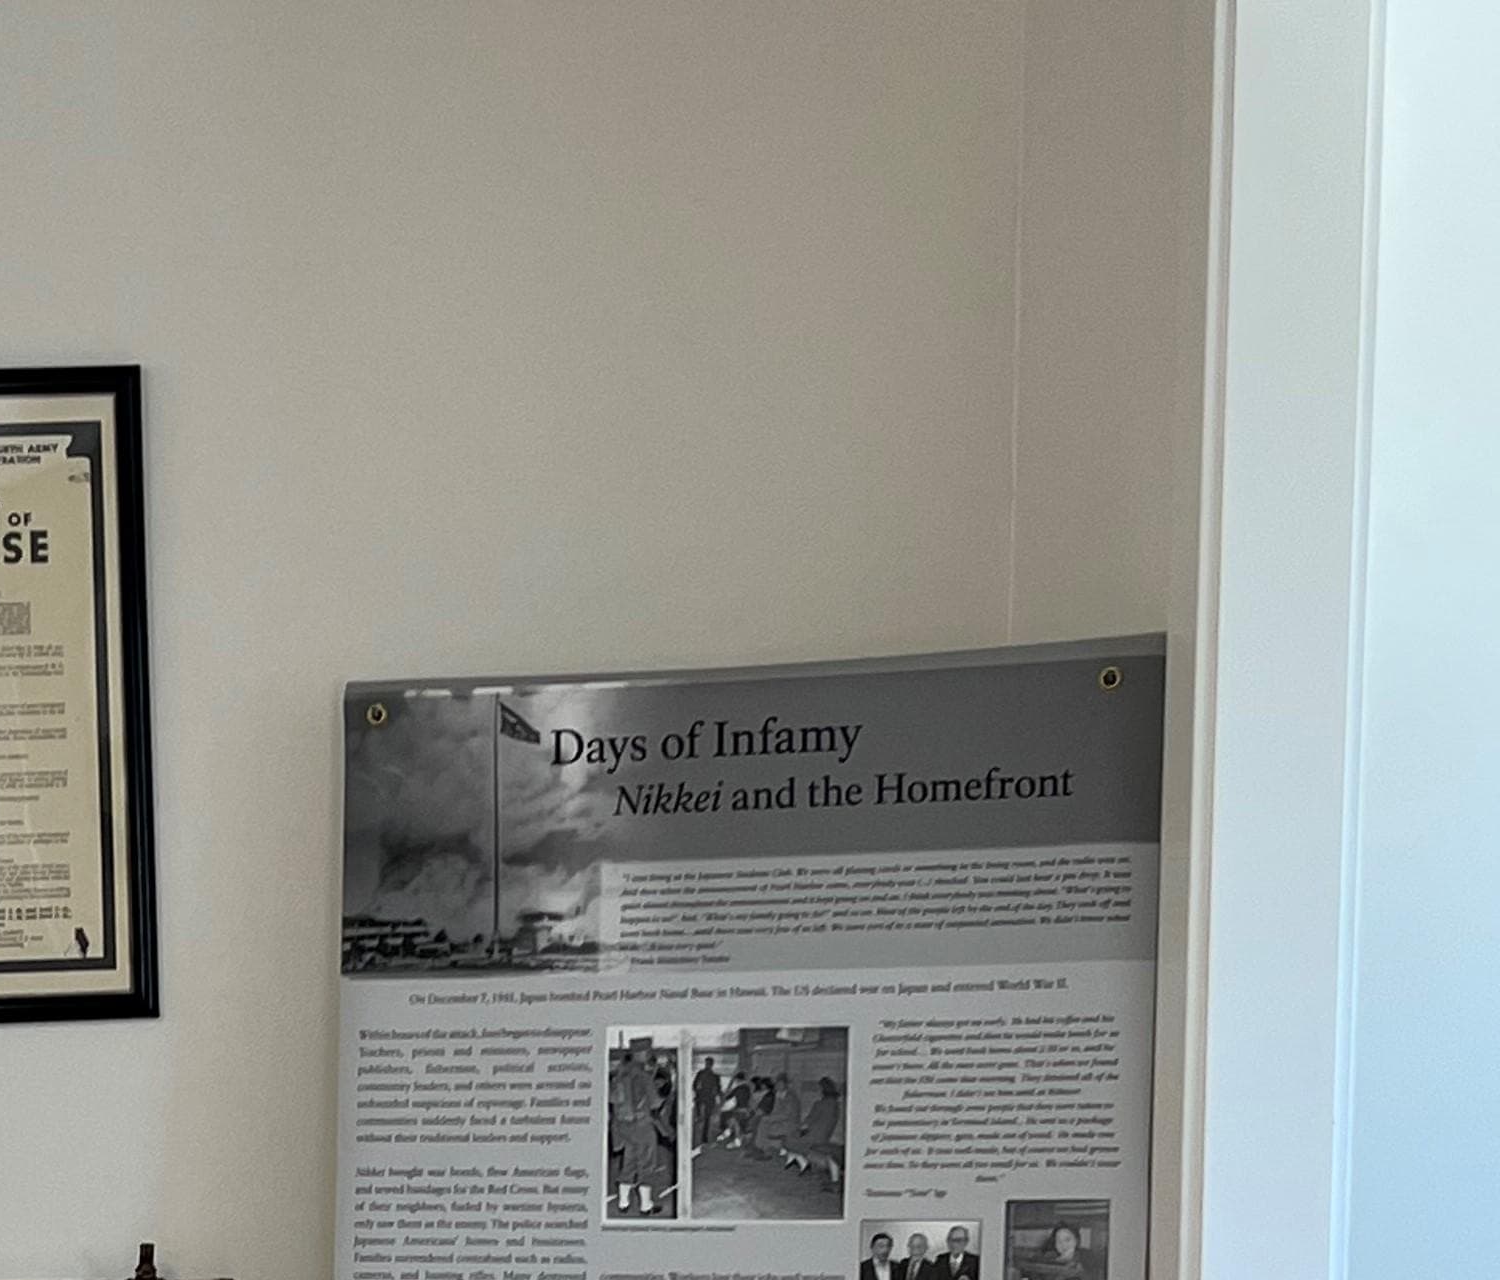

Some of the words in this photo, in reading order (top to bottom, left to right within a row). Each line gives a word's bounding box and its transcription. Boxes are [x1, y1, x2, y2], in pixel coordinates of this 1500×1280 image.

[28, 443, 58, 453] ARMY
[7, 512, 32, 527] OF
[551, 722, 648, 774] Days
[660, 719, 703, 761] of
[712, 718, 864, 763] Infamy
[614, 780, 725, 816] Nikkei
[731, 776, 795, 812] and
[806, 774, 864, 809] the
[876, 766, 1074, 806] Homefront
[427, 993, 479, 1004] December
[519, 993, 548, 1004] Japan
[592, 990, 618, 1000] Pearl
[619, 990, 657, 1000] Harbor
[771, 985, 792, 996] The
[811, 985, 858, 995] declared
[898, 984, 929, 995] Japan
[930, 983, 952, 992] and
[996, 979, 1031, 990] World
[1032, 979, 1054, 989] War
